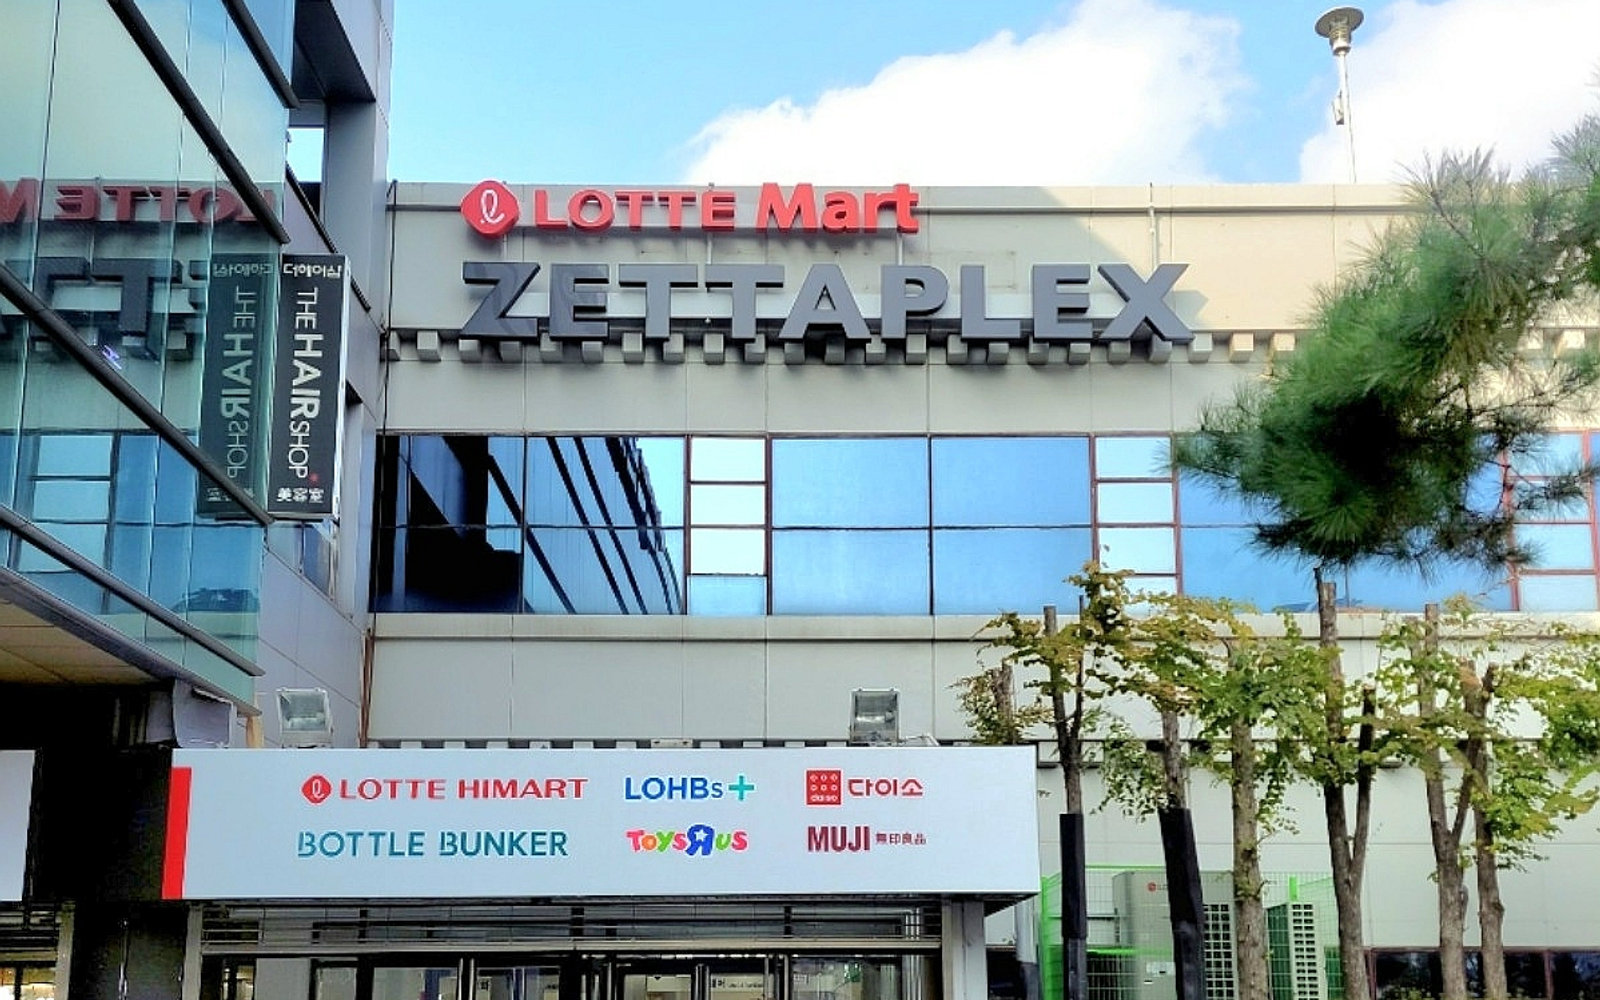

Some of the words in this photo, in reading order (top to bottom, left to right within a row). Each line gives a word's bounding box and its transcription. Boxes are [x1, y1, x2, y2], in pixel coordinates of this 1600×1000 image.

[534, 188, 735, 232] LOTTE
[756, 182, 919, 234] Mart
[459, 260, 1194, 342] ZETTAPLEX
[340, 778, 446, 800] LOTTE
[458, 778, 588, 799] HIMART
[847, 778, 923, 797] 다이소
[297, 831, 425, 856] BOTTLE
[438, 831, 569, 856] BUNKER
[807, 825, 870, 852] MUJI
